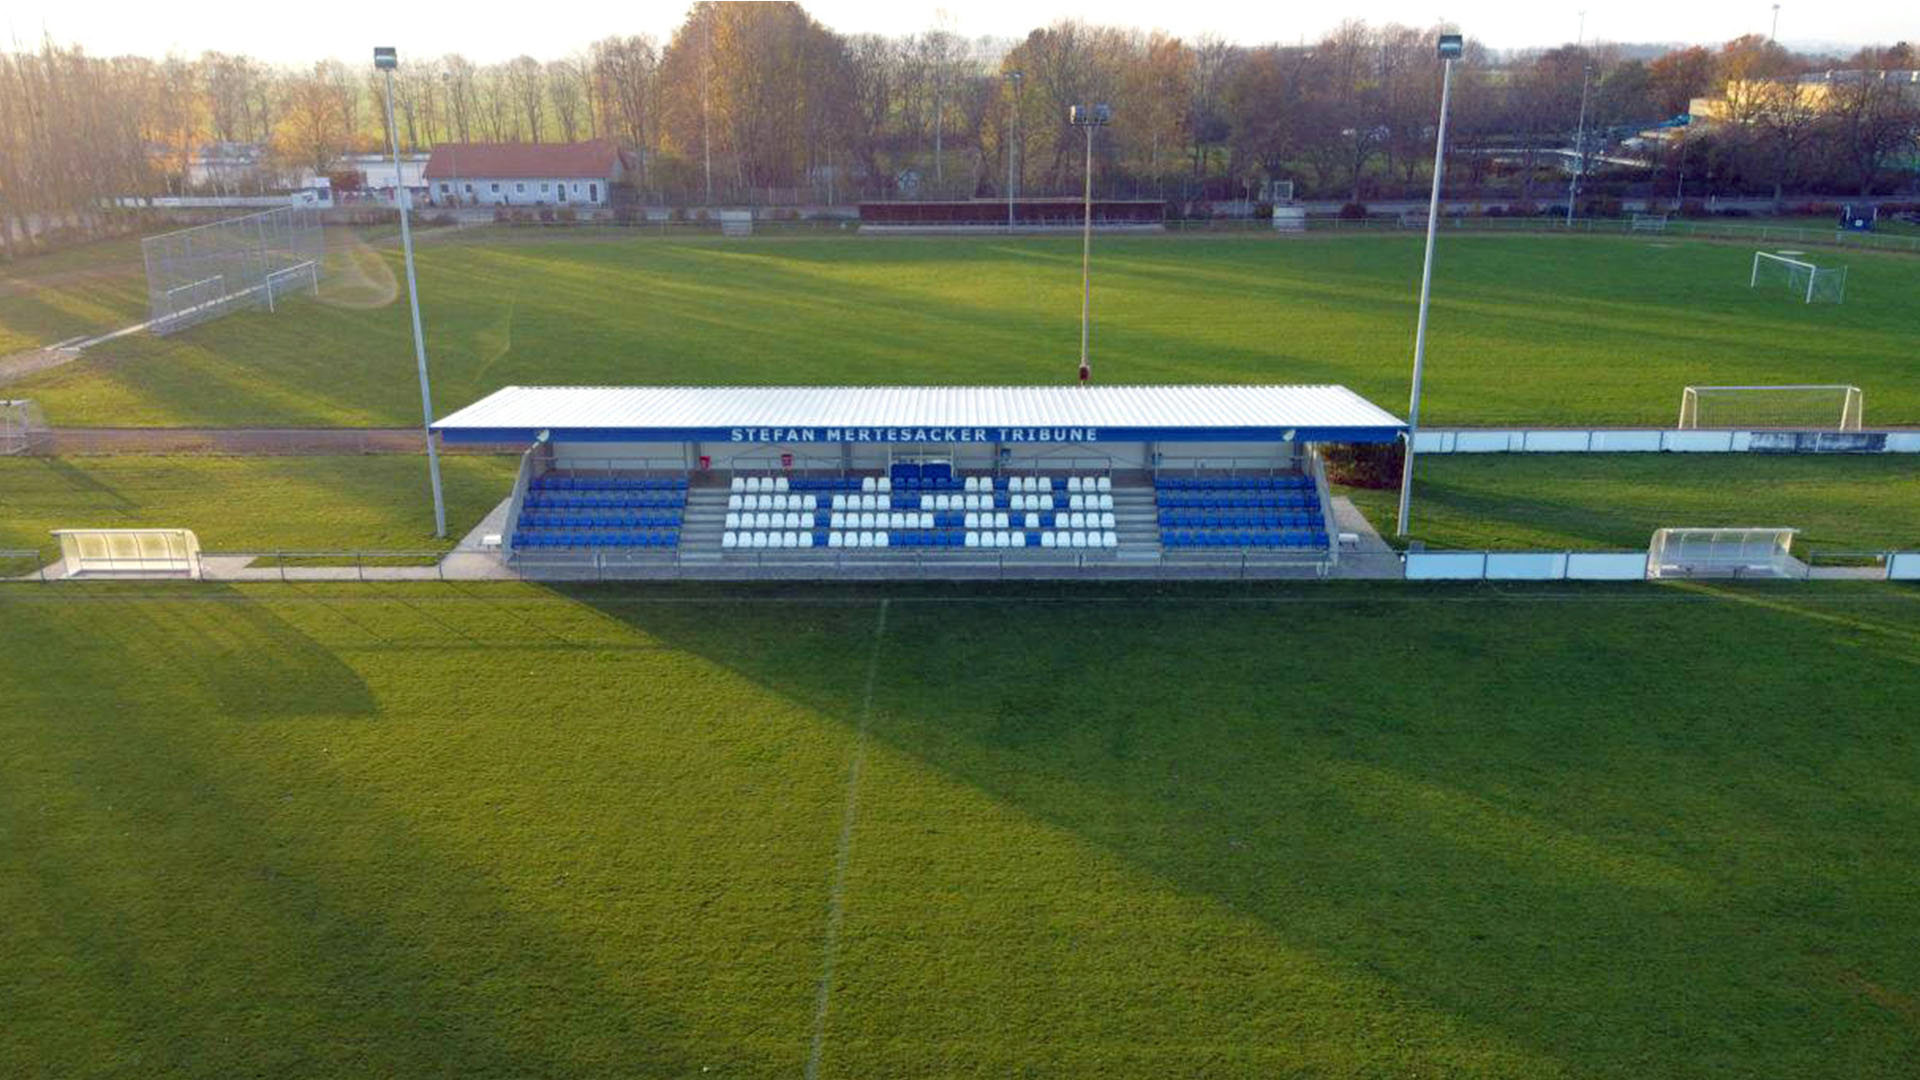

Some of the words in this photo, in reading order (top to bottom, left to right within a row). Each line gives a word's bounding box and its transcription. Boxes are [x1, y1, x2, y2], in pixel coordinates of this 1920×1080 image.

[731, 428, 815, 442] STEFAN
[826, 428, 987, 442] MERTESACKER
[999, 428, 1098, 442] TRIBUNE
